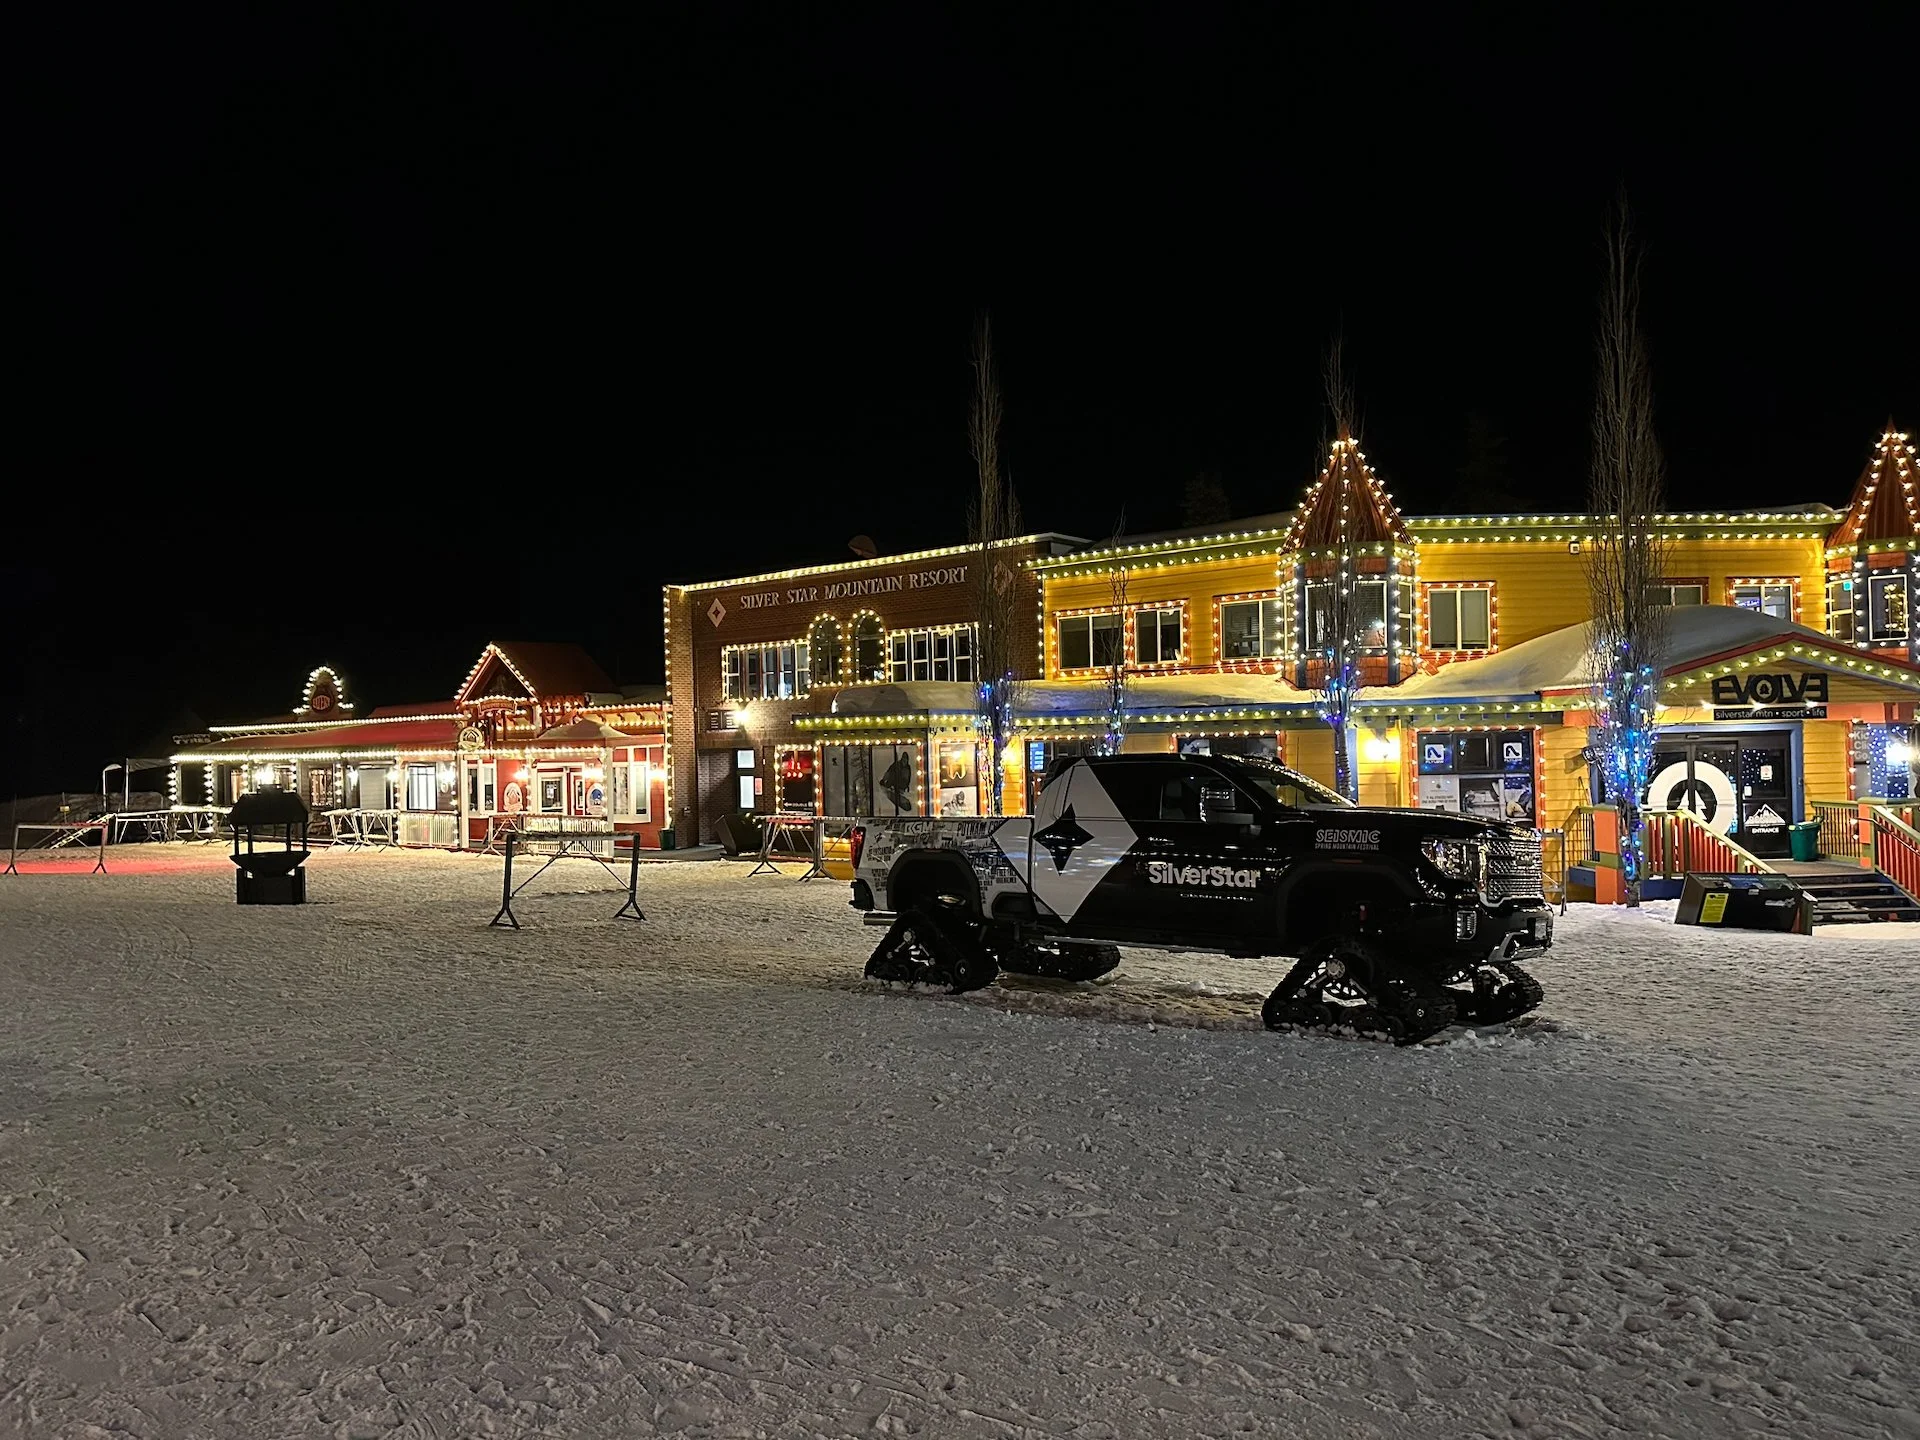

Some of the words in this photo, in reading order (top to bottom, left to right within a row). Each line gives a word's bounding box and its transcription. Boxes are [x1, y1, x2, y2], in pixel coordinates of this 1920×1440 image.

[740, 592, 780, 610] SILVER
[787, 586, 818, 604] STAR
[824, 576, 903, 600] MOUNTAIN
[909, 566, 968, 590] RESORT
[1711, 673, 1829, 705] EVOLVE
[1715, 708, 1755, 720] silverstar
[1755, 708, 1774, 719] mtn
[1781, 708, 1804, 719] sport
[1812, 707, 1825, 718] life
[1315, 829, 1381, 844] SEISMIC
[1357, 843, 1380, 851] FESTIVAL
[1148, 861, 1261, 889] SilverStar
